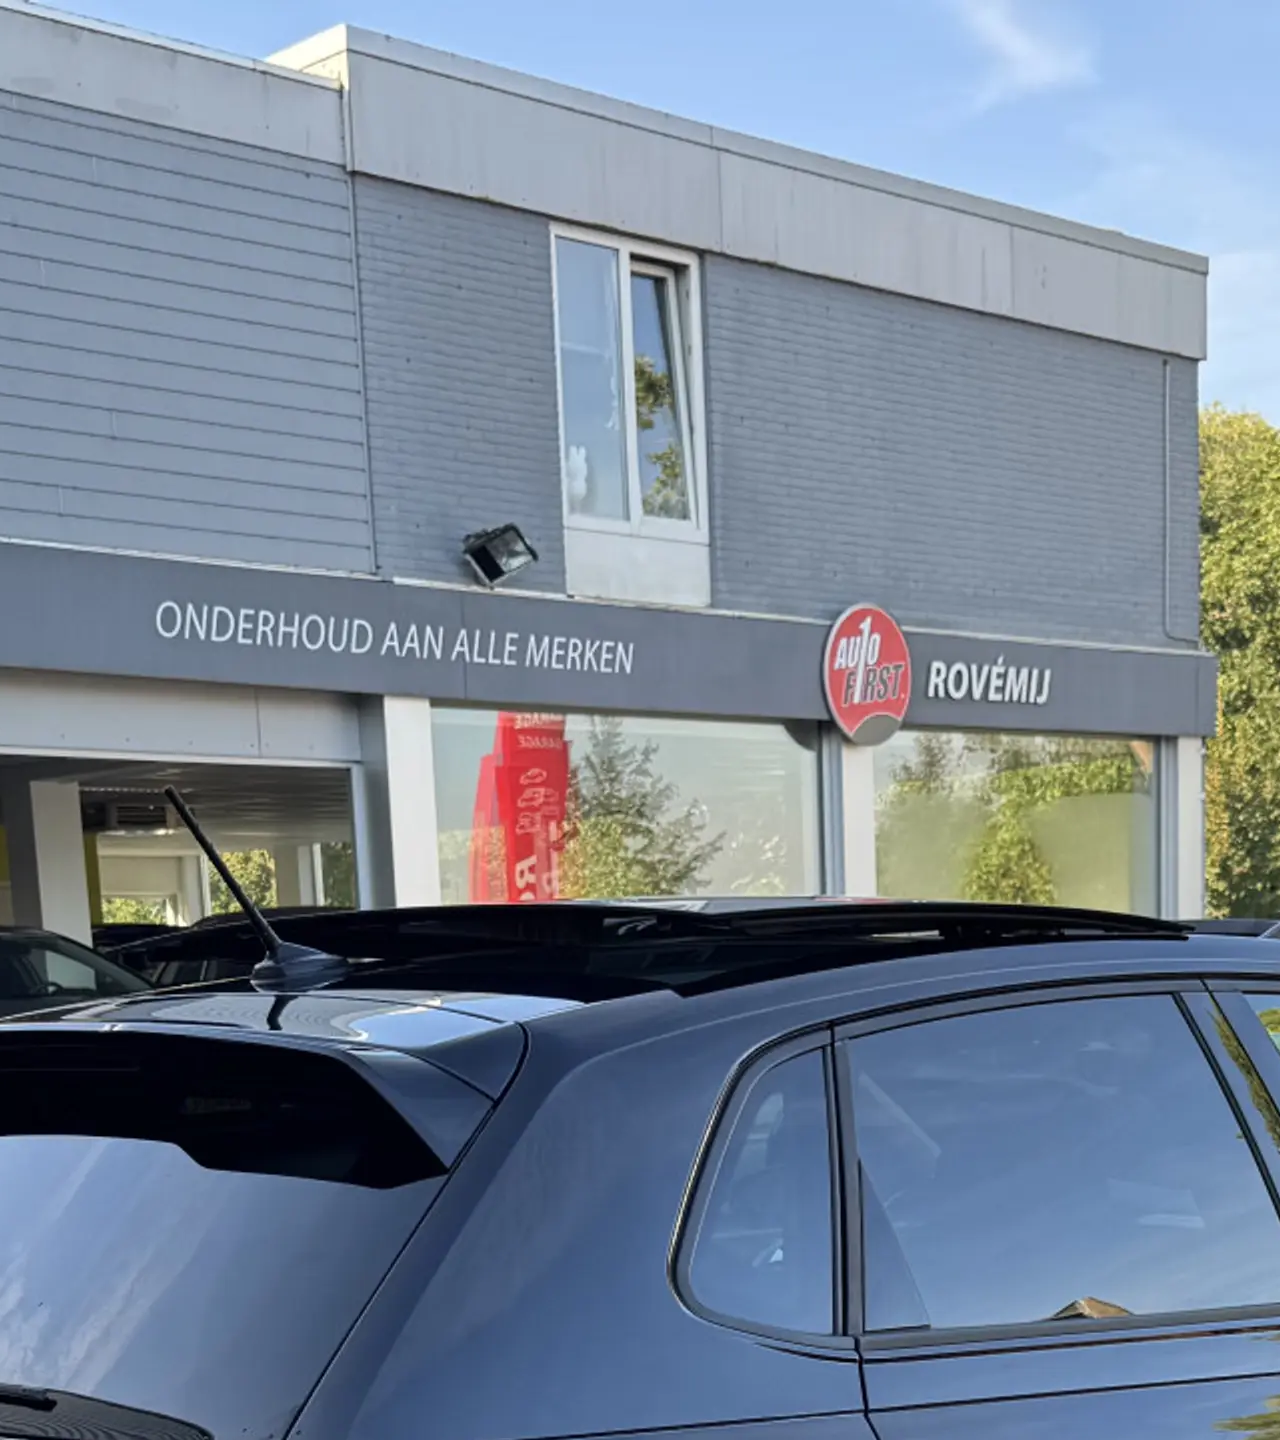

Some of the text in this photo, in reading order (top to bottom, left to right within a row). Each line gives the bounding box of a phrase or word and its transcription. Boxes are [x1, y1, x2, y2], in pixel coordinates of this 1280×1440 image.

[156, 600, 634, 675] ONDERHOUD AAN ALLE MERKEN
[928, 653, 1052, 705] ROVÉMIJ
